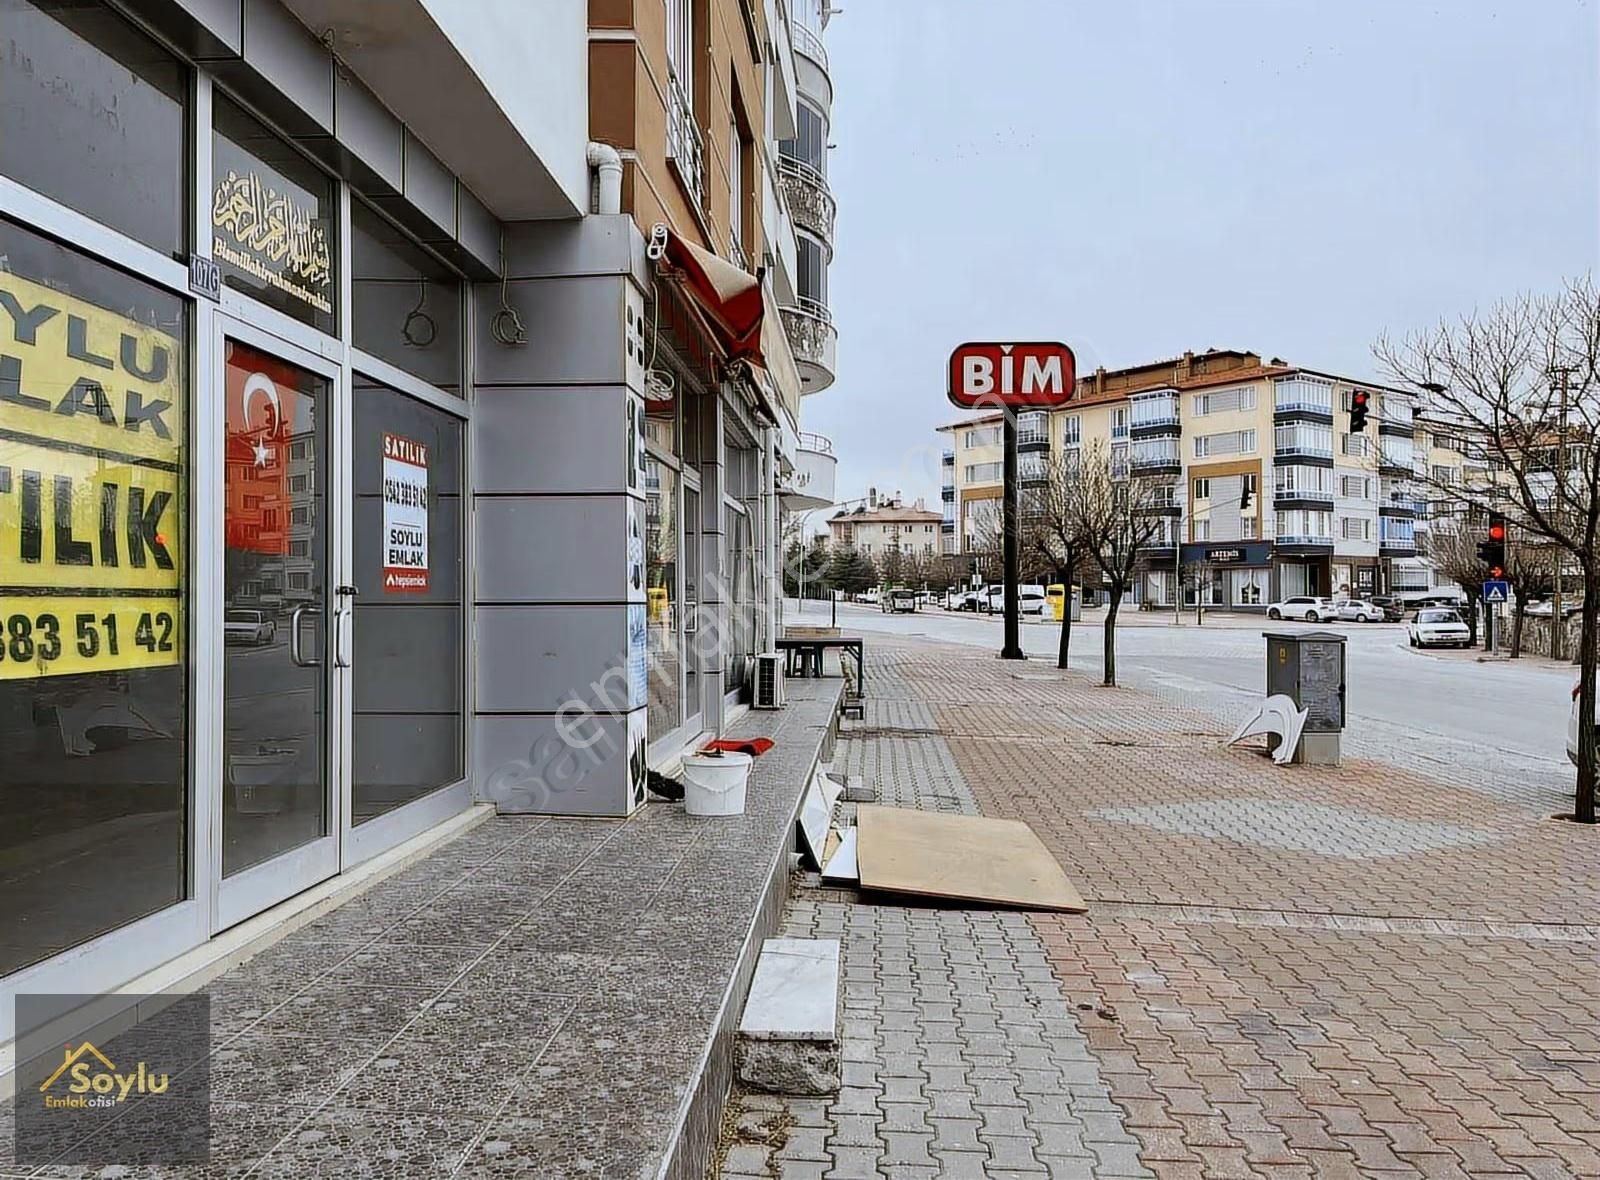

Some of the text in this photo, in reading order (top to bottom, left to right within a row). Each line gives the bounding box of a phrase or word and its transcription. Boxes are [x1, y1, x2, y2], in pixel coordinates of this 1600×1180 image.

[963, 345, 1063, 395] BİM
[385, 436, 427, 465] SATILIK
[390, 529, 423, 547] SOYLU
[389, 549, 424, 567] EMLAK
[0, 611, 174, 663] 83 51 42
